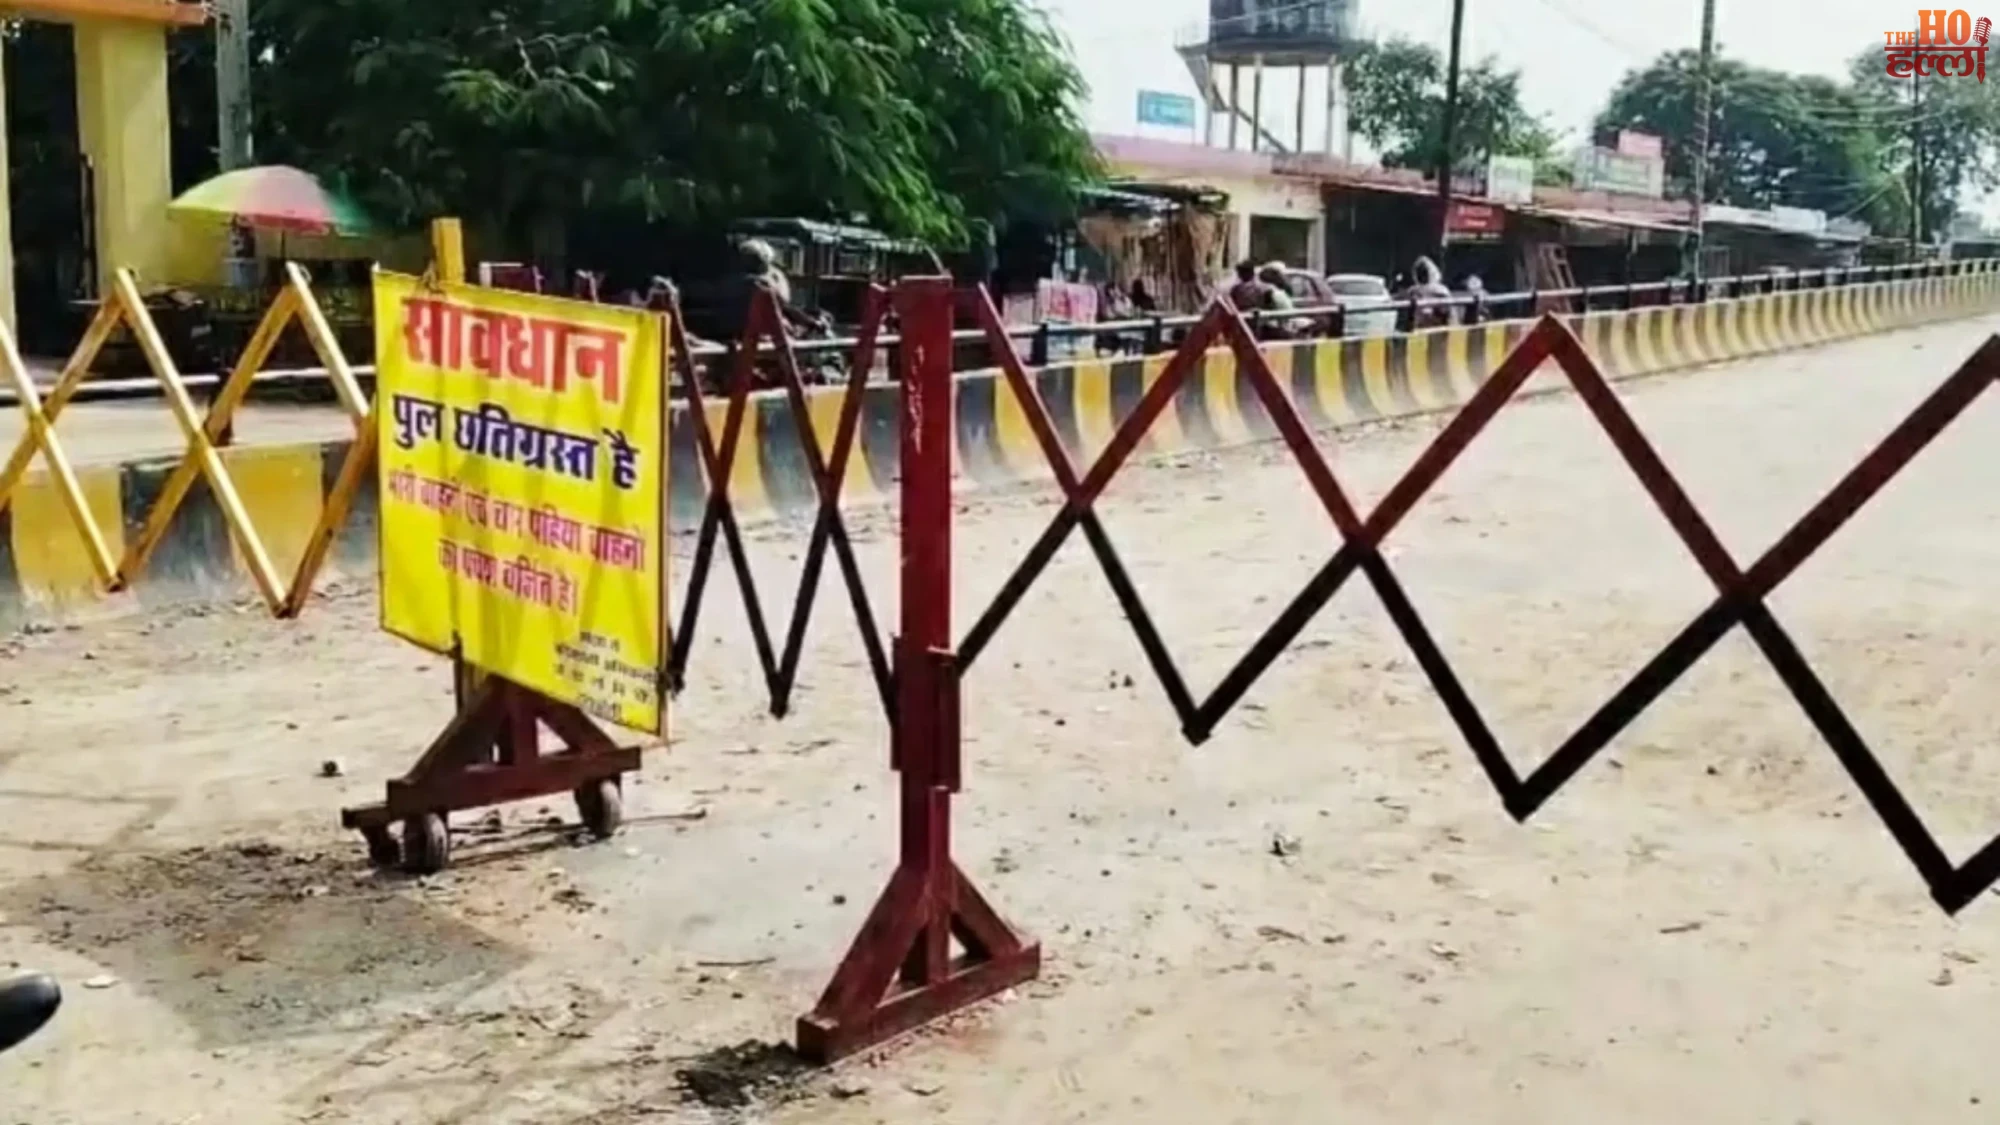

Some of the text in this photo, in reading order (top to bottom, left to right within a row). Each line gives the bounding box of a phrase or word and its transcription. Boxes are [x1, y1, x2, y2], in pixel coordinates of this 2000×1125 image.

[402, 296, 625, 403] सावधान
[392, 393, 444, 449] पुल
[602, 427, 640, 488] है
[529, 503, 581, 553] पहिया
